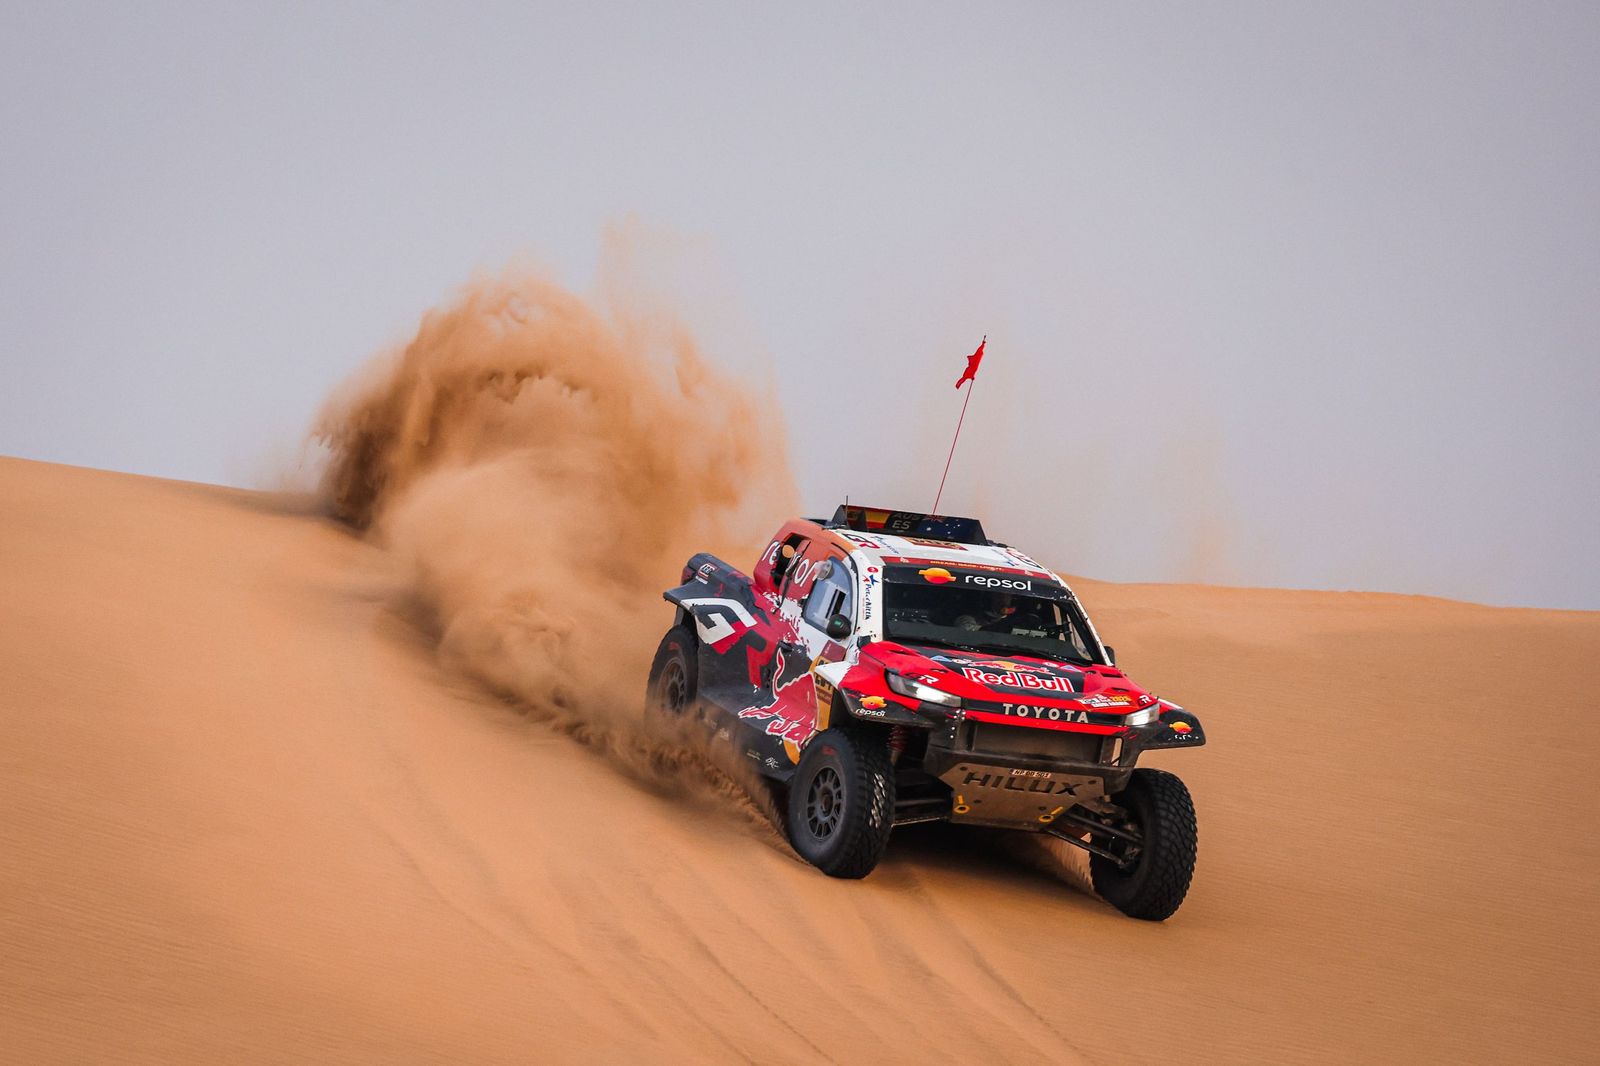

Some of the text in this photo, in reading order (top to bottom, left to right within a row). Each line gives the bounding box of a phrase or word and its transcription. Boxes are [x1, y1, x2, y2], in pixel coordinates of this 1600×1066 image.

[891, 520, 911, 530] ES
[965, 575, 1032, 591] repsol
[961, 667, 1075, 693] Red Bull
[1002, 703, 1089, 724] TOYOTA
[962, 771, 1083, 797] HILUX
